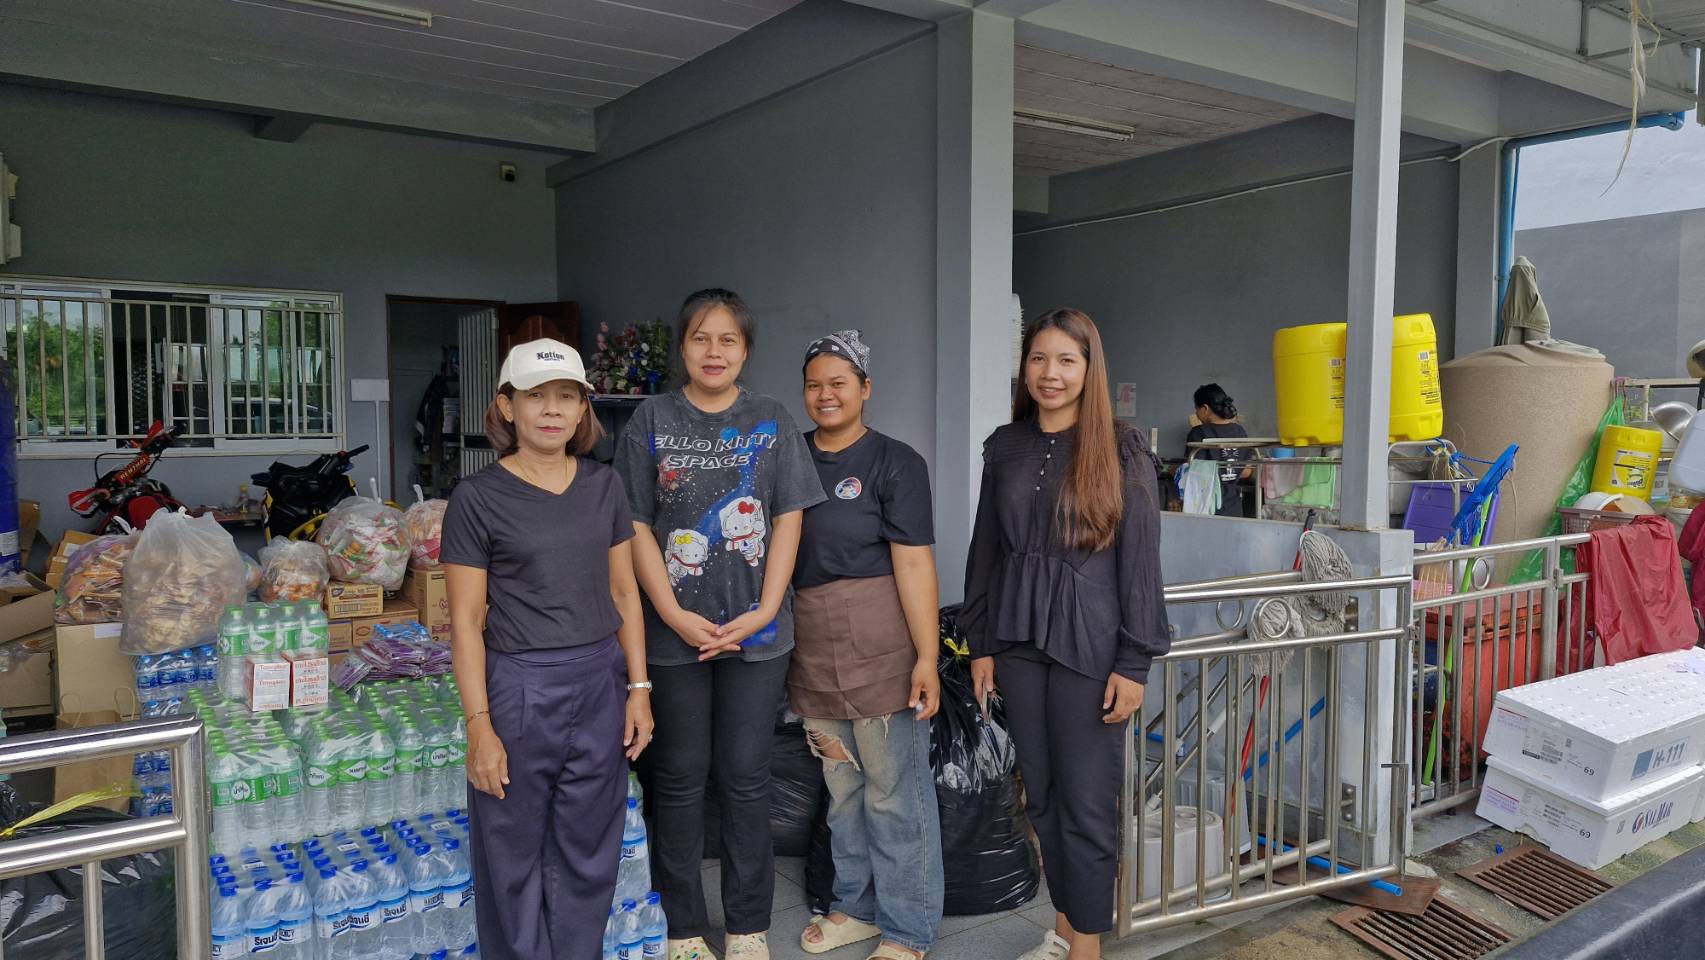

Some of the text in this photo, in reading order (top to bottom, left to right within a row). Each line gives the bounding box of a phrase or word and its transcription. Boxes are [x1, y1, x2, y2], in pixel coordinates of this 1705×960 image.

[655, 432, 777, 452] ELLO KITTY
[668, 452, 752, 469] SPACE
[1583, 766, 1595, 776] 69
